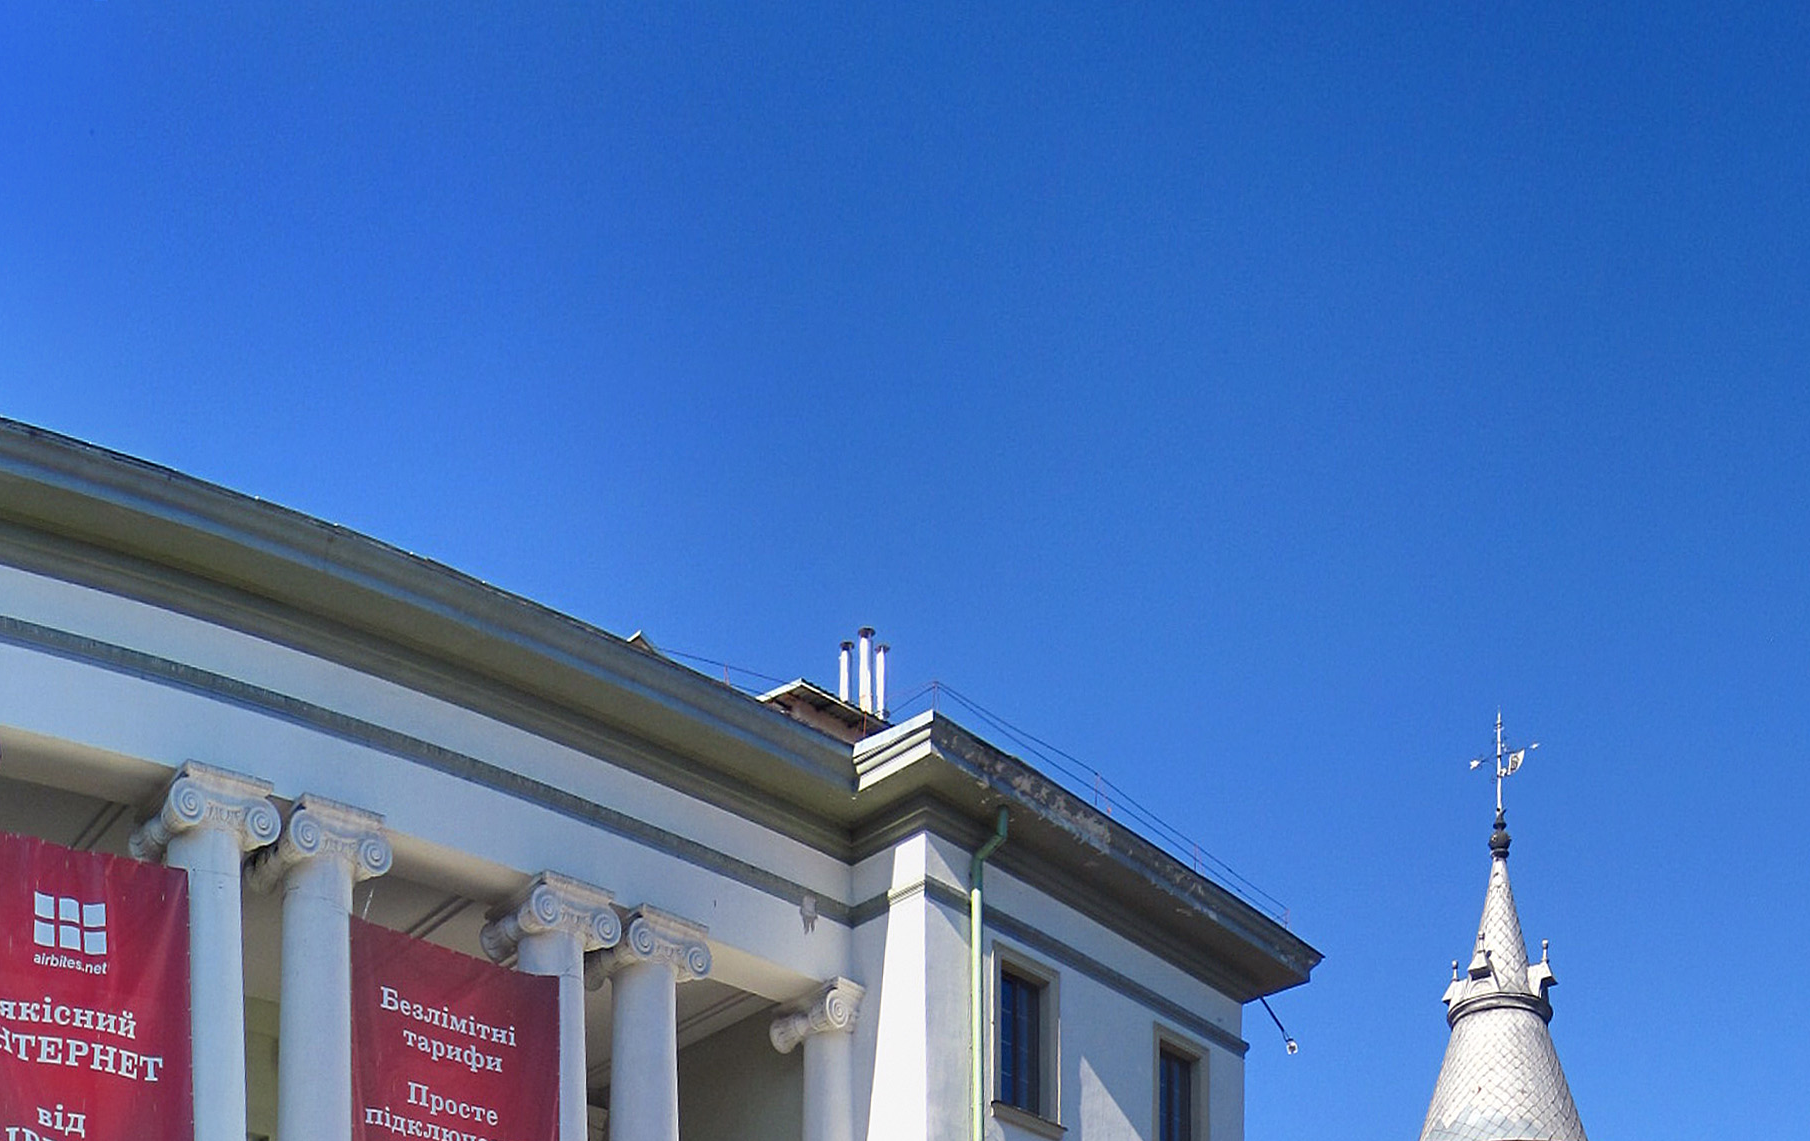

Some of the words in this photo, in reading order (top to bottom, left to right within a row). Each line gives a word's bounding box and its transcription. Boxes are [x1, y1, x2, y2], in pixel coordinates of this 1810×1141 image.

[33, 953, 107, 974] airbites.net
[0, 996, 137, 1040] якісний
[380, 985, 517, 1047] Безлімітні
[403, 1029, 503, 1073] тарифи
[37, 1103, 87, 1138] від
[407, 1081, 499, 1126] Просте
